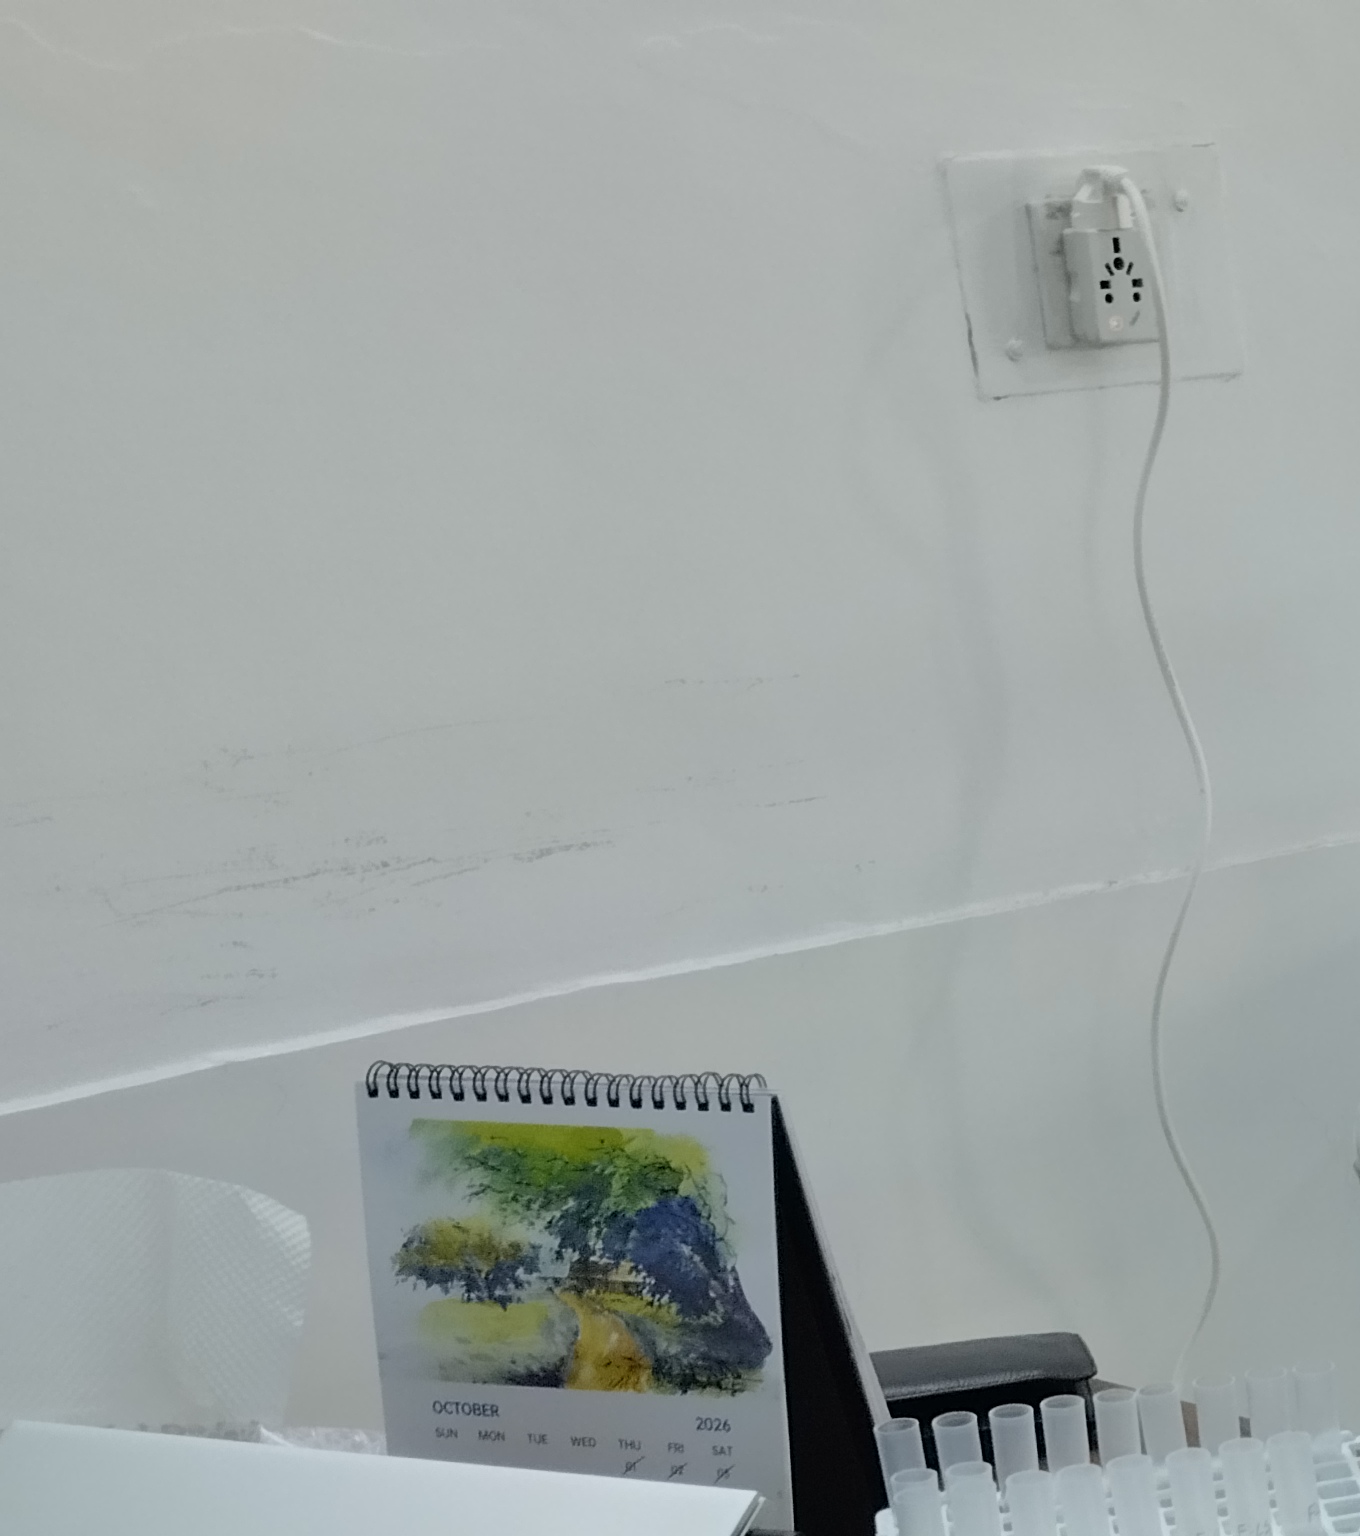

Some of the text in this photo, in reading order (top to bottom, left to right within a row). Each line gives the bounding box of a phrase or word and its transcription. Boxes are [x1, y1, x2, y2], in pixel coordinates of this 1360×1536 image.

[432, 1400, 732, 1433] OCTOBER 2026
[435, 1427, 733, 1457] SUN MON TUE WED THU FRI SAT
